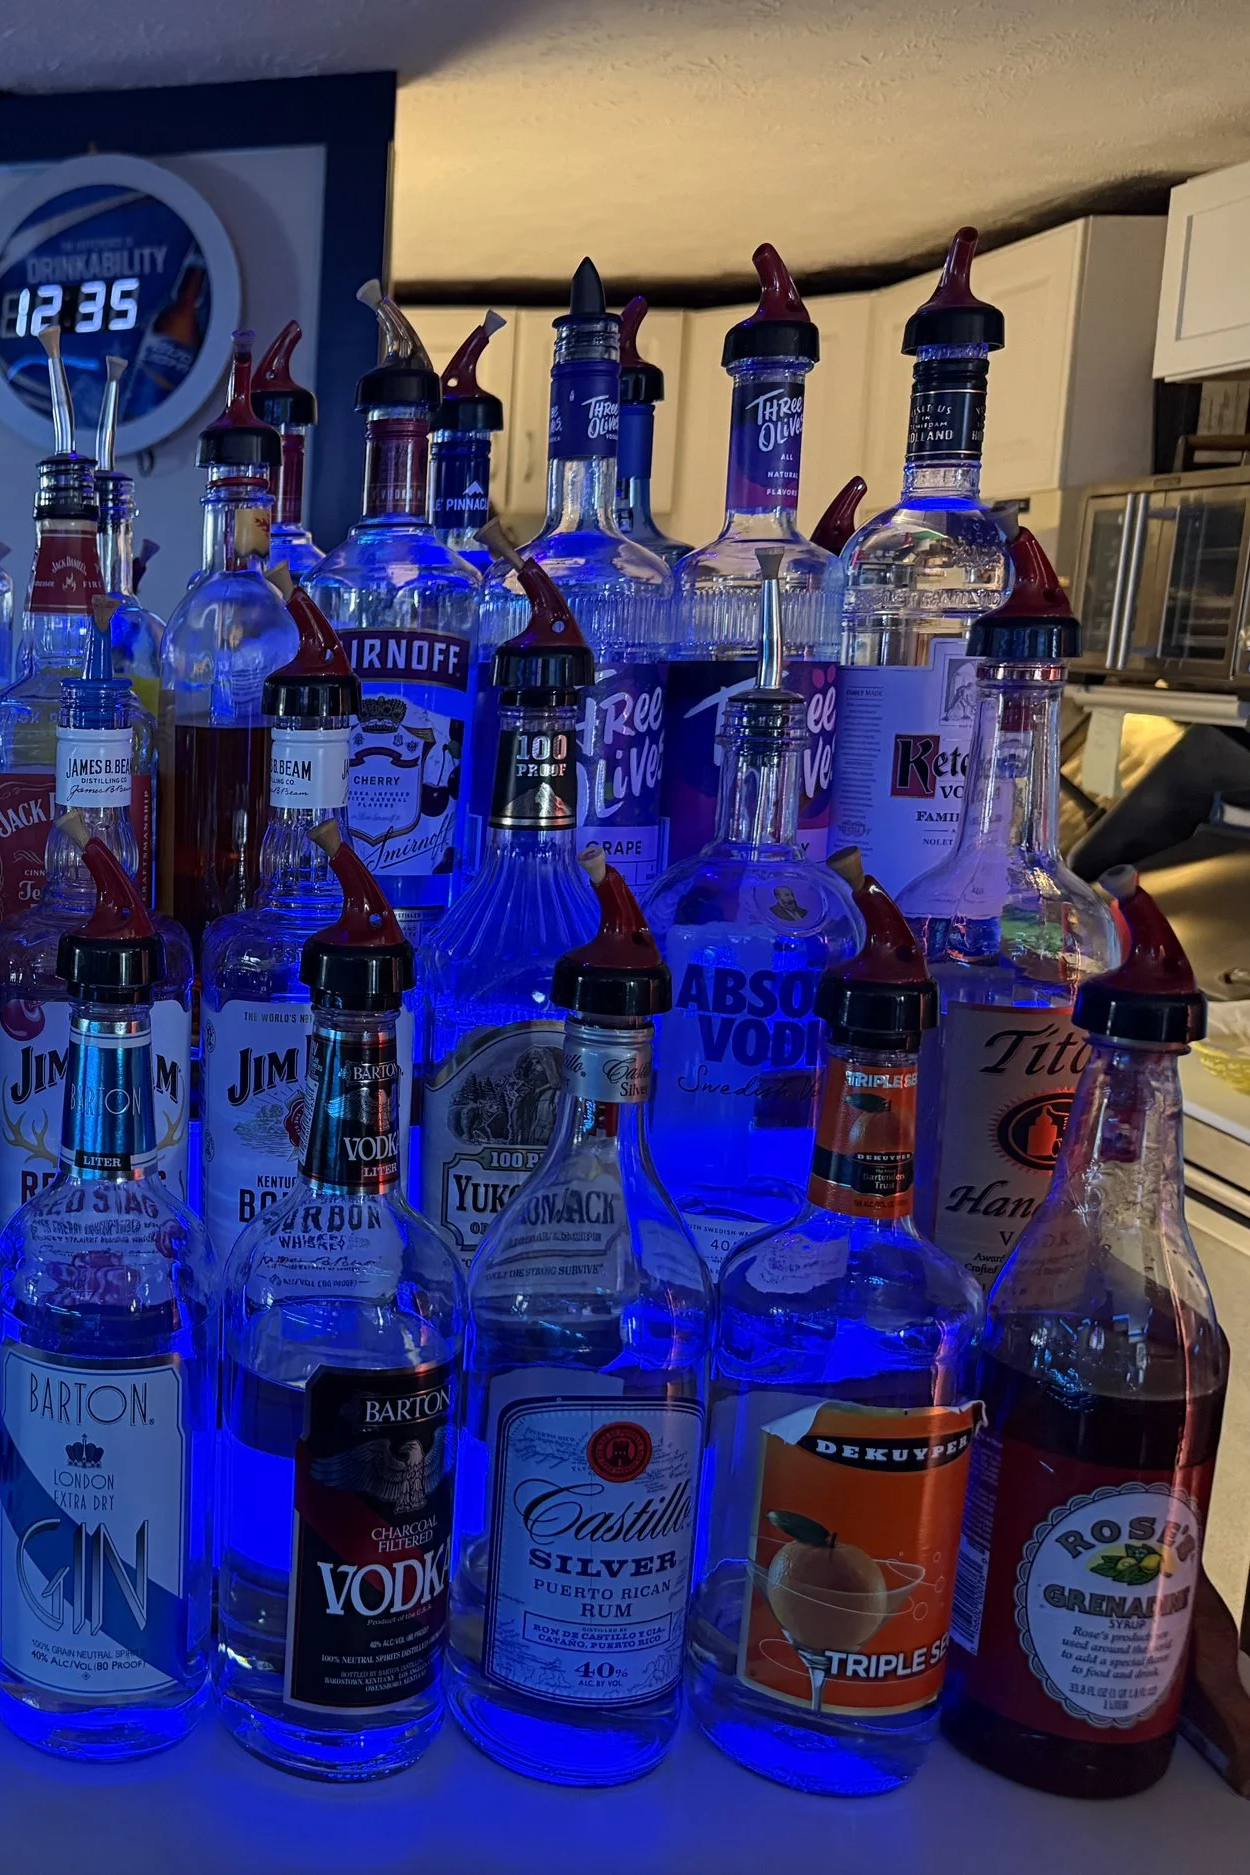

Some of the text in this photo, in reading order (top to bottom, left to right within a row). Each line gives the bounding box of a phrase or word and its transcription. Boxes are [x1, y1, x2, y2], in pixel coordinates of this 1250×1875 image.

[26, 246, 168, 284] DRINKABILITY
[780, 453, 794, 461] ALL
[767, 471, 799, 479] NATURAL
[766, 488, 798, 496] FLAVORS
[516, 734, 568, 761] 100
[65, 757, 103, 779] JAMES
[279, 760, 312, 782] BEAM
[516, 763, 567, 778] PROOF
[354, 775, 400, 787] CHERRY
[244, 1011, 298, 1023] THE WORLD'S
[227, 1046, 297, 1106] JIM
[353, 1061, 400, 1081] BARTON
[846, 1070, 903, 1089] TRIPLE
[677, 1064, 792, 1101] Swedish
[70, 1087, 142, 1117] BARTON
[83, 1154, 122, 1168] LITER
[490, 1150, 520, 1168] 100
[857, 1153, 911, 1161] DEKUYPER
[363, 1162, 398, 1178] LITER
[703, 1226, 737, 1236] SWEDISH
[29, 1371, 152, 1427] BARTON
[365, 1385, 452, 1424] BARTON
[815, 1436, 969, 1463] DEKUYPER
[53, 1469, 115, 1491] LONDON
[54, 1493, 115, 1512] EXTRA DRY
[371, 1514, 439, 1542] CHARCOAL
[378, 1529, 434, 1553] FILTERED
[528, 1547, 677, 1579] SILVER
[15, 1518, 150, 1637] GIN
[533, 1578, 672, 1601] PUERTO RICAN
[579, 1602, 633, 1618] RUM
[366, 1616, 397, 1627] Product
[1108, 1619, 1147, 1631] SYRUP
[533, 1623, 637, 1642] RON DE CASTILLO
[1072, 1625, 1109, 1640] Rose's
[590, 1640, 636, 1650] PUERTO
[637, 1634, 662, 1647] RICO
[1061, 1637, 1131, 1654] used around
[51, 1645, 113, 1659] GRAIN NEUTRAL
[321, 1652, 401, 1665] 100% NEUTRAL SPIRITS
[1074, 1652, 1145, 1669] add special
[573, 1661, 629, 1679] 40%
[825, 1649, 926, 1679] TRIPLE
[1083, 1665, 1133, 1679] food and
